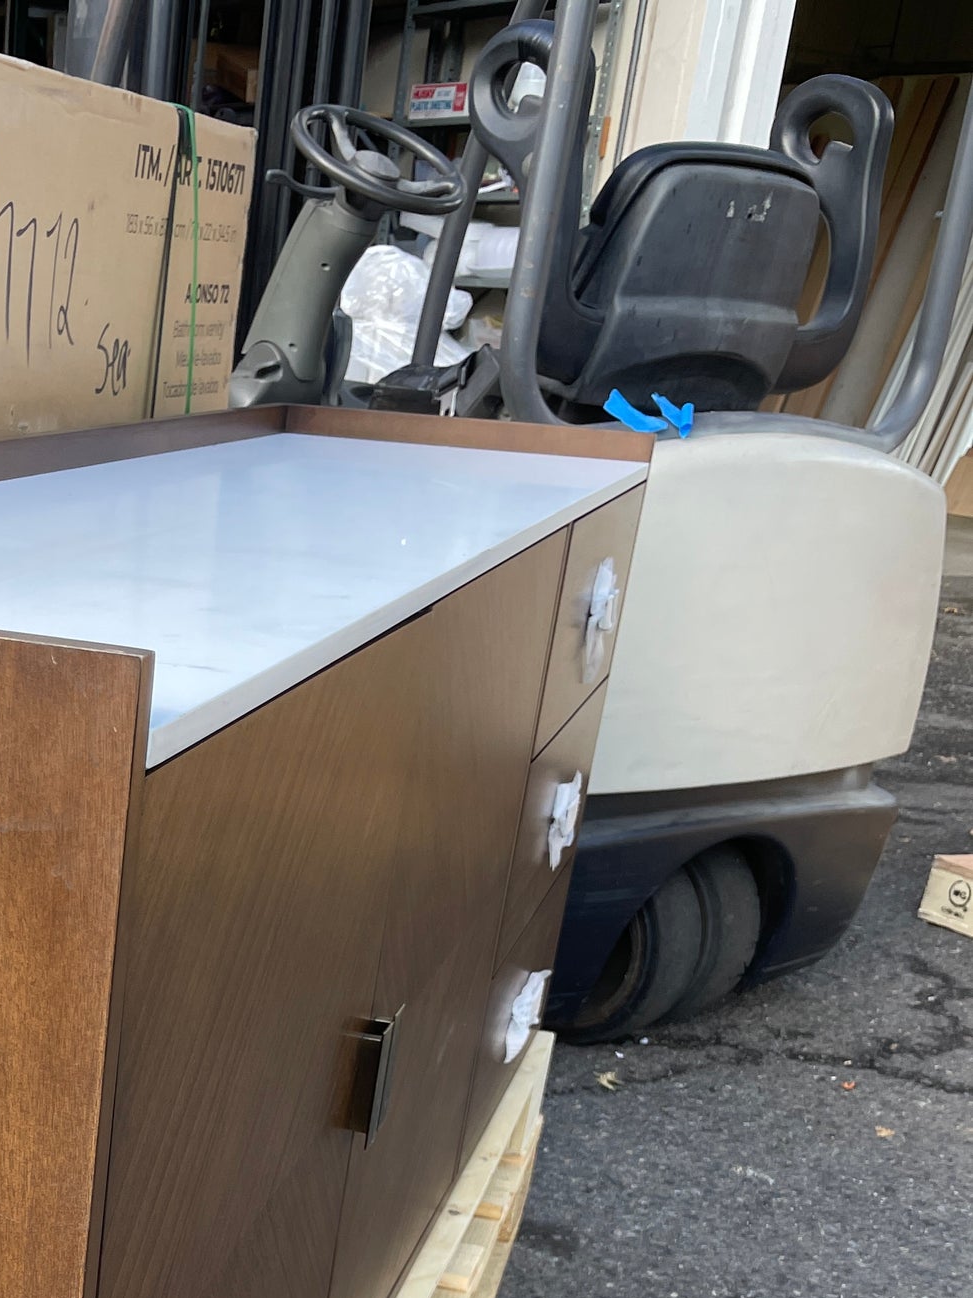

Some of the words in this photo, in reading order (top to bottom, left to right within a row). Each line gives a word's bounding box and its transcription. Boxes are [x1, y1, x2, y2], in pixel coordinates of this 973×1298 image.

[134, 143, 162, 181] ITM.
[205, 158, 246, 195] 1510671
[184, 283, 219, 304] AONSO
